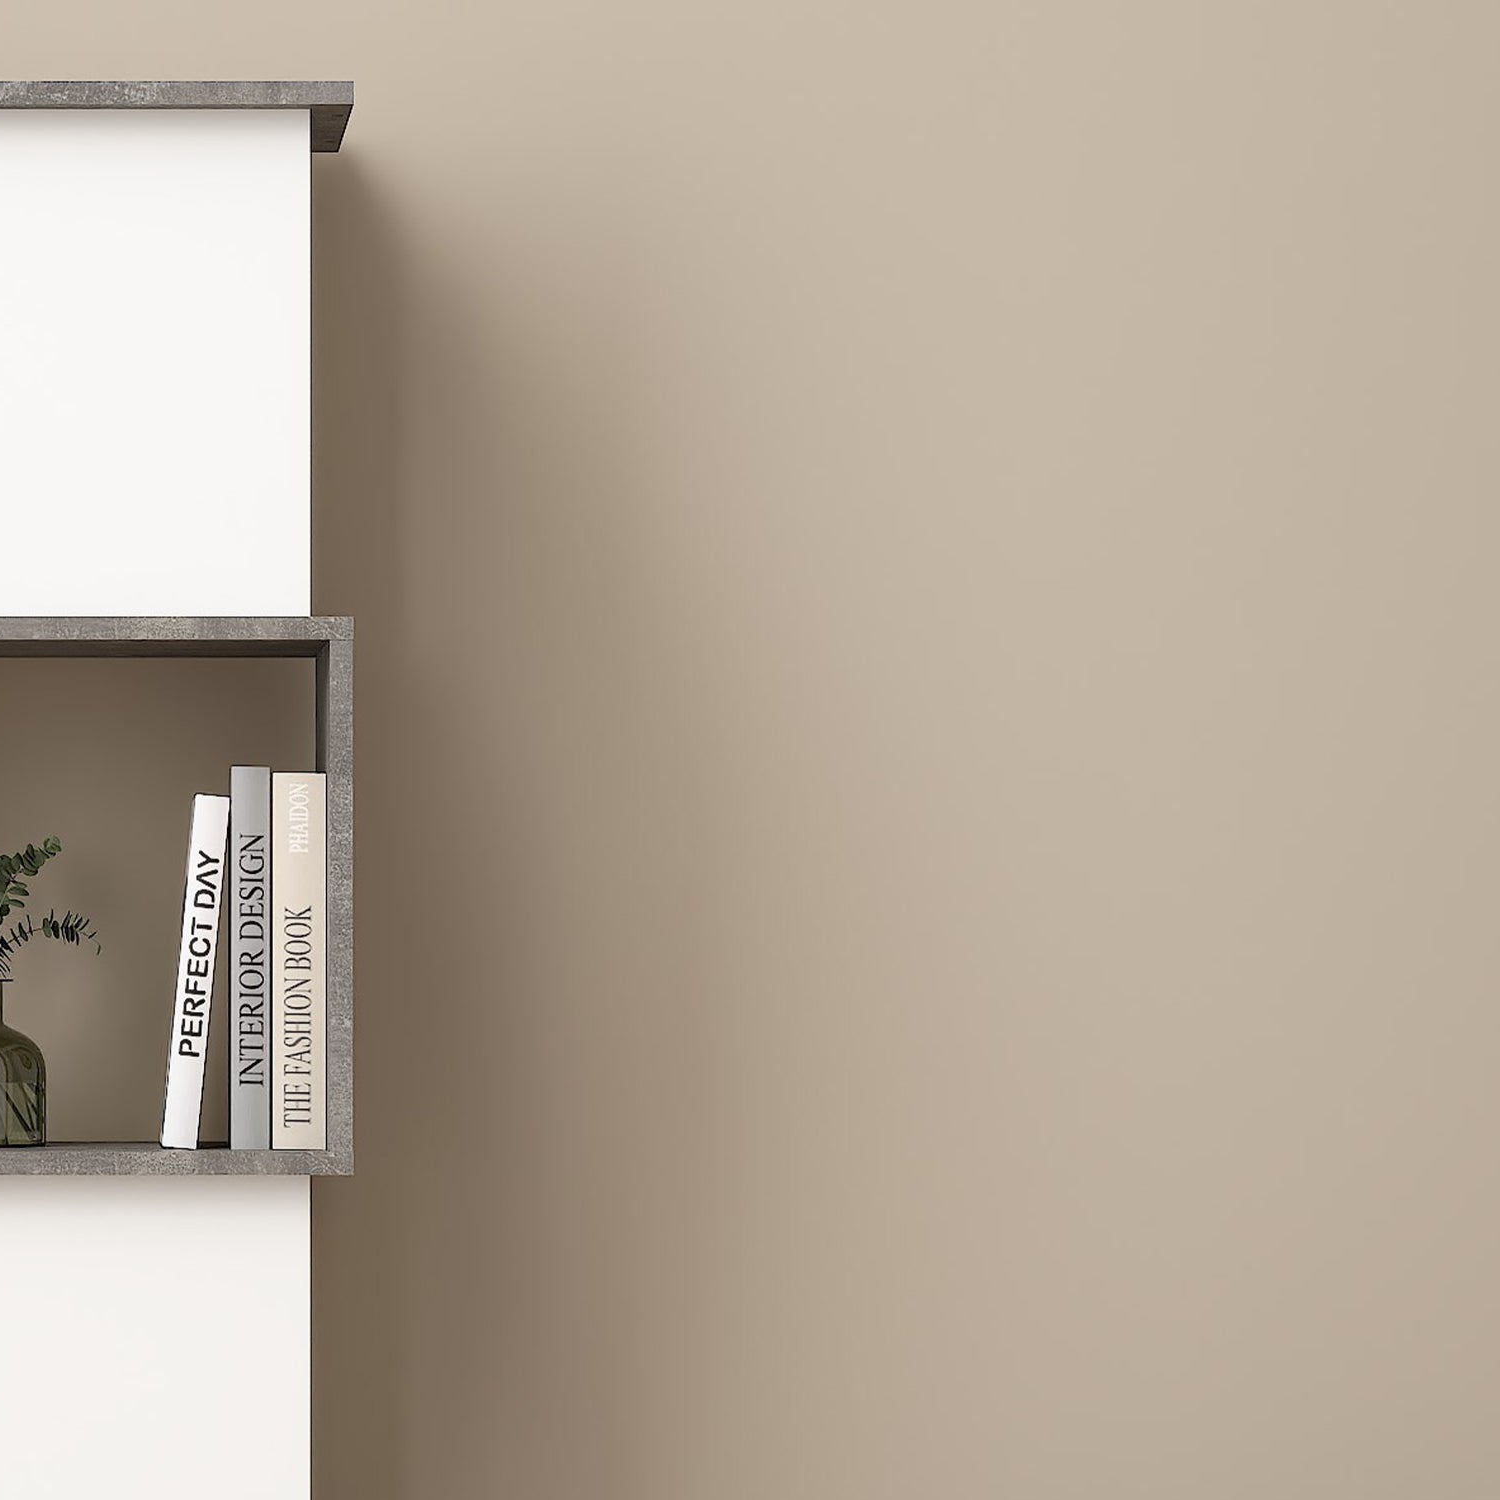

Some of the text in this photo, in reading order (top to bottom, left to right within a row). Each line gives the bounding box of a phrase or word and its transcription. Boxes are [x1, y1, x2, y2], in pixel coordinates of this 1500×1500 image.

[289, 783, 309, 854] PHAIDON
[178, 850, 220, 1057] PERFECT DAY
[238, 833, 264, 1087] INTERIOR DESIGN
[283, 905, 311, 1129] THE FASHION BOOK
